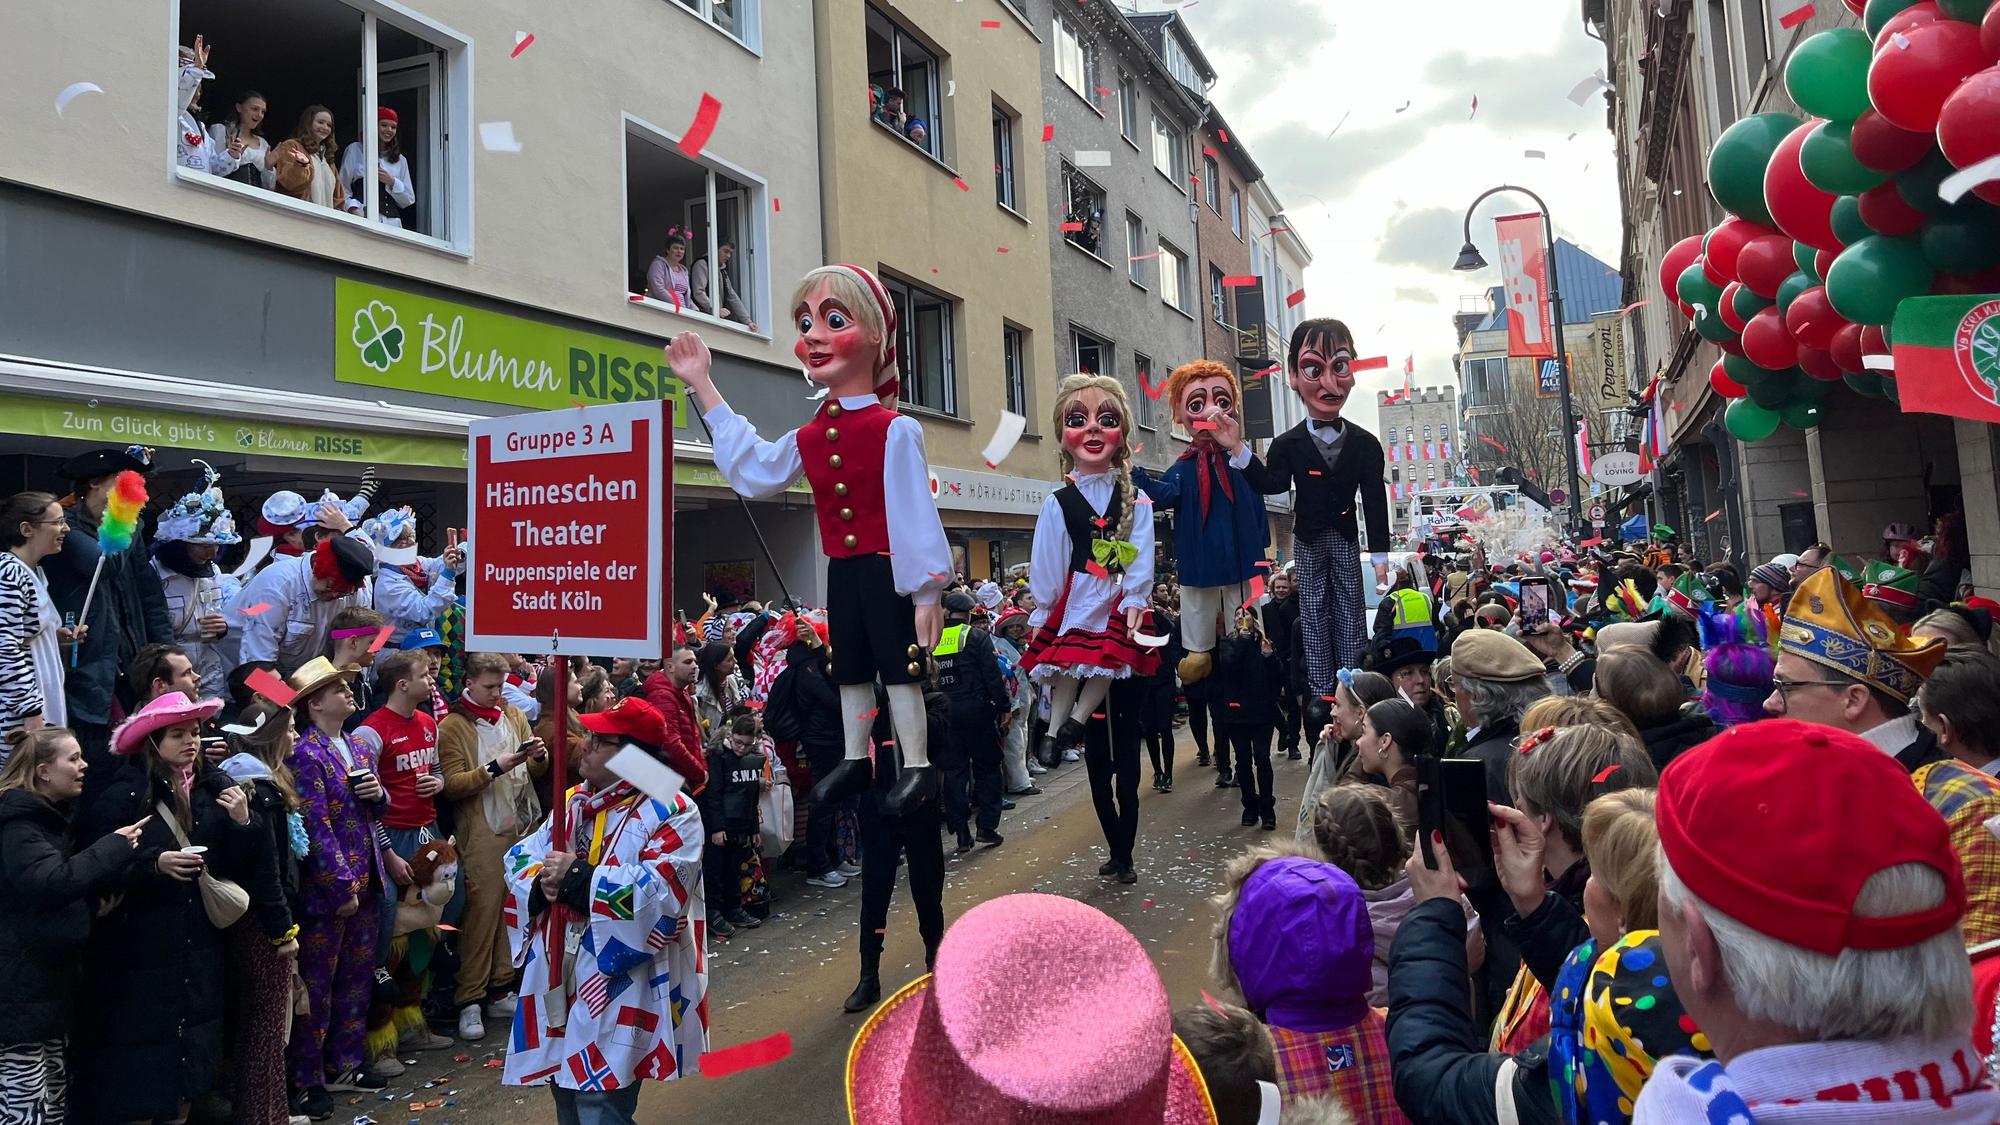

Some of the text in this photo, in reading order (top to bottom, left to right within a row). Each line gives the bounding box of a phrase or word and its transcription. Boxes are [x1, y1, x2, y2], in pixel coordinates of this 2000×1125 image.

[418, 312, 678, 411] Blumen RISSE
[1598, 325, 1621, 400] Peperoni
[63, 411, 363, 455] Zum Glück gibt's Blumen RISSE
[506, 422, 614, 454] Gruppe 3 A
[1604, 461, 1634, 469] KEEP
[1605, 468, 1634, 476] LOVING
[486, 473, 637, 508] Hänneschen
[511, 519, 607, 547] Theater
[485, 560, 637, 586] Puppenspiele der
[512, 590, 602, 611] Stadt Köln
